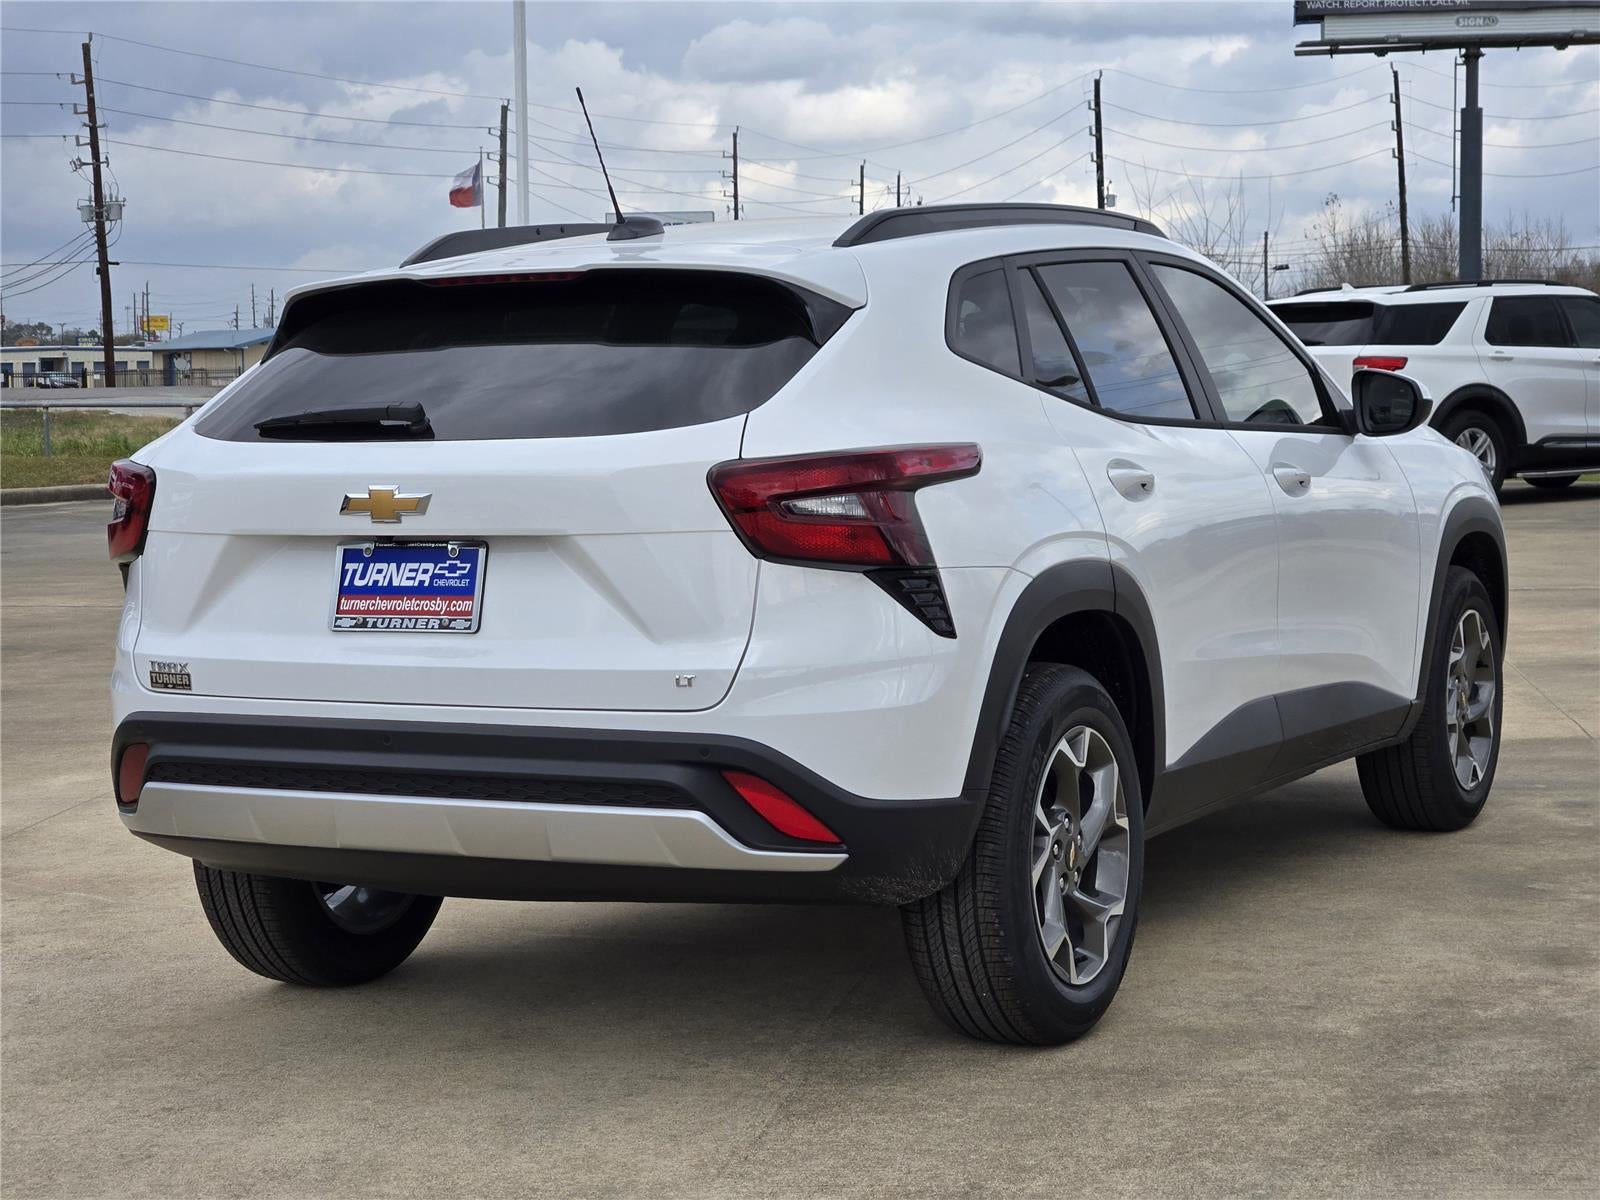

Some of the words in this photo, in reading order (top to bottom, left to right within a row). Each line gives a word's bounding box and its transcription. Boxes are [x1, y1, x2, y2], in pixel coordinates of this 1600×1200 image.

[1306, 0, 1342, 9] WATCH.
[1344, 0, 1383, 8] REPORT.
[343, 562, 435, 587] TURNER
[433, 578, 470, 587] CHEVROLET
[340, 597, 473, 615] turnerchevroletcrosby.com
[366, 618, 440, 629] TURNER
[151, 673, 190, 685] TURNER
[675, 674, 697, 688] LT
